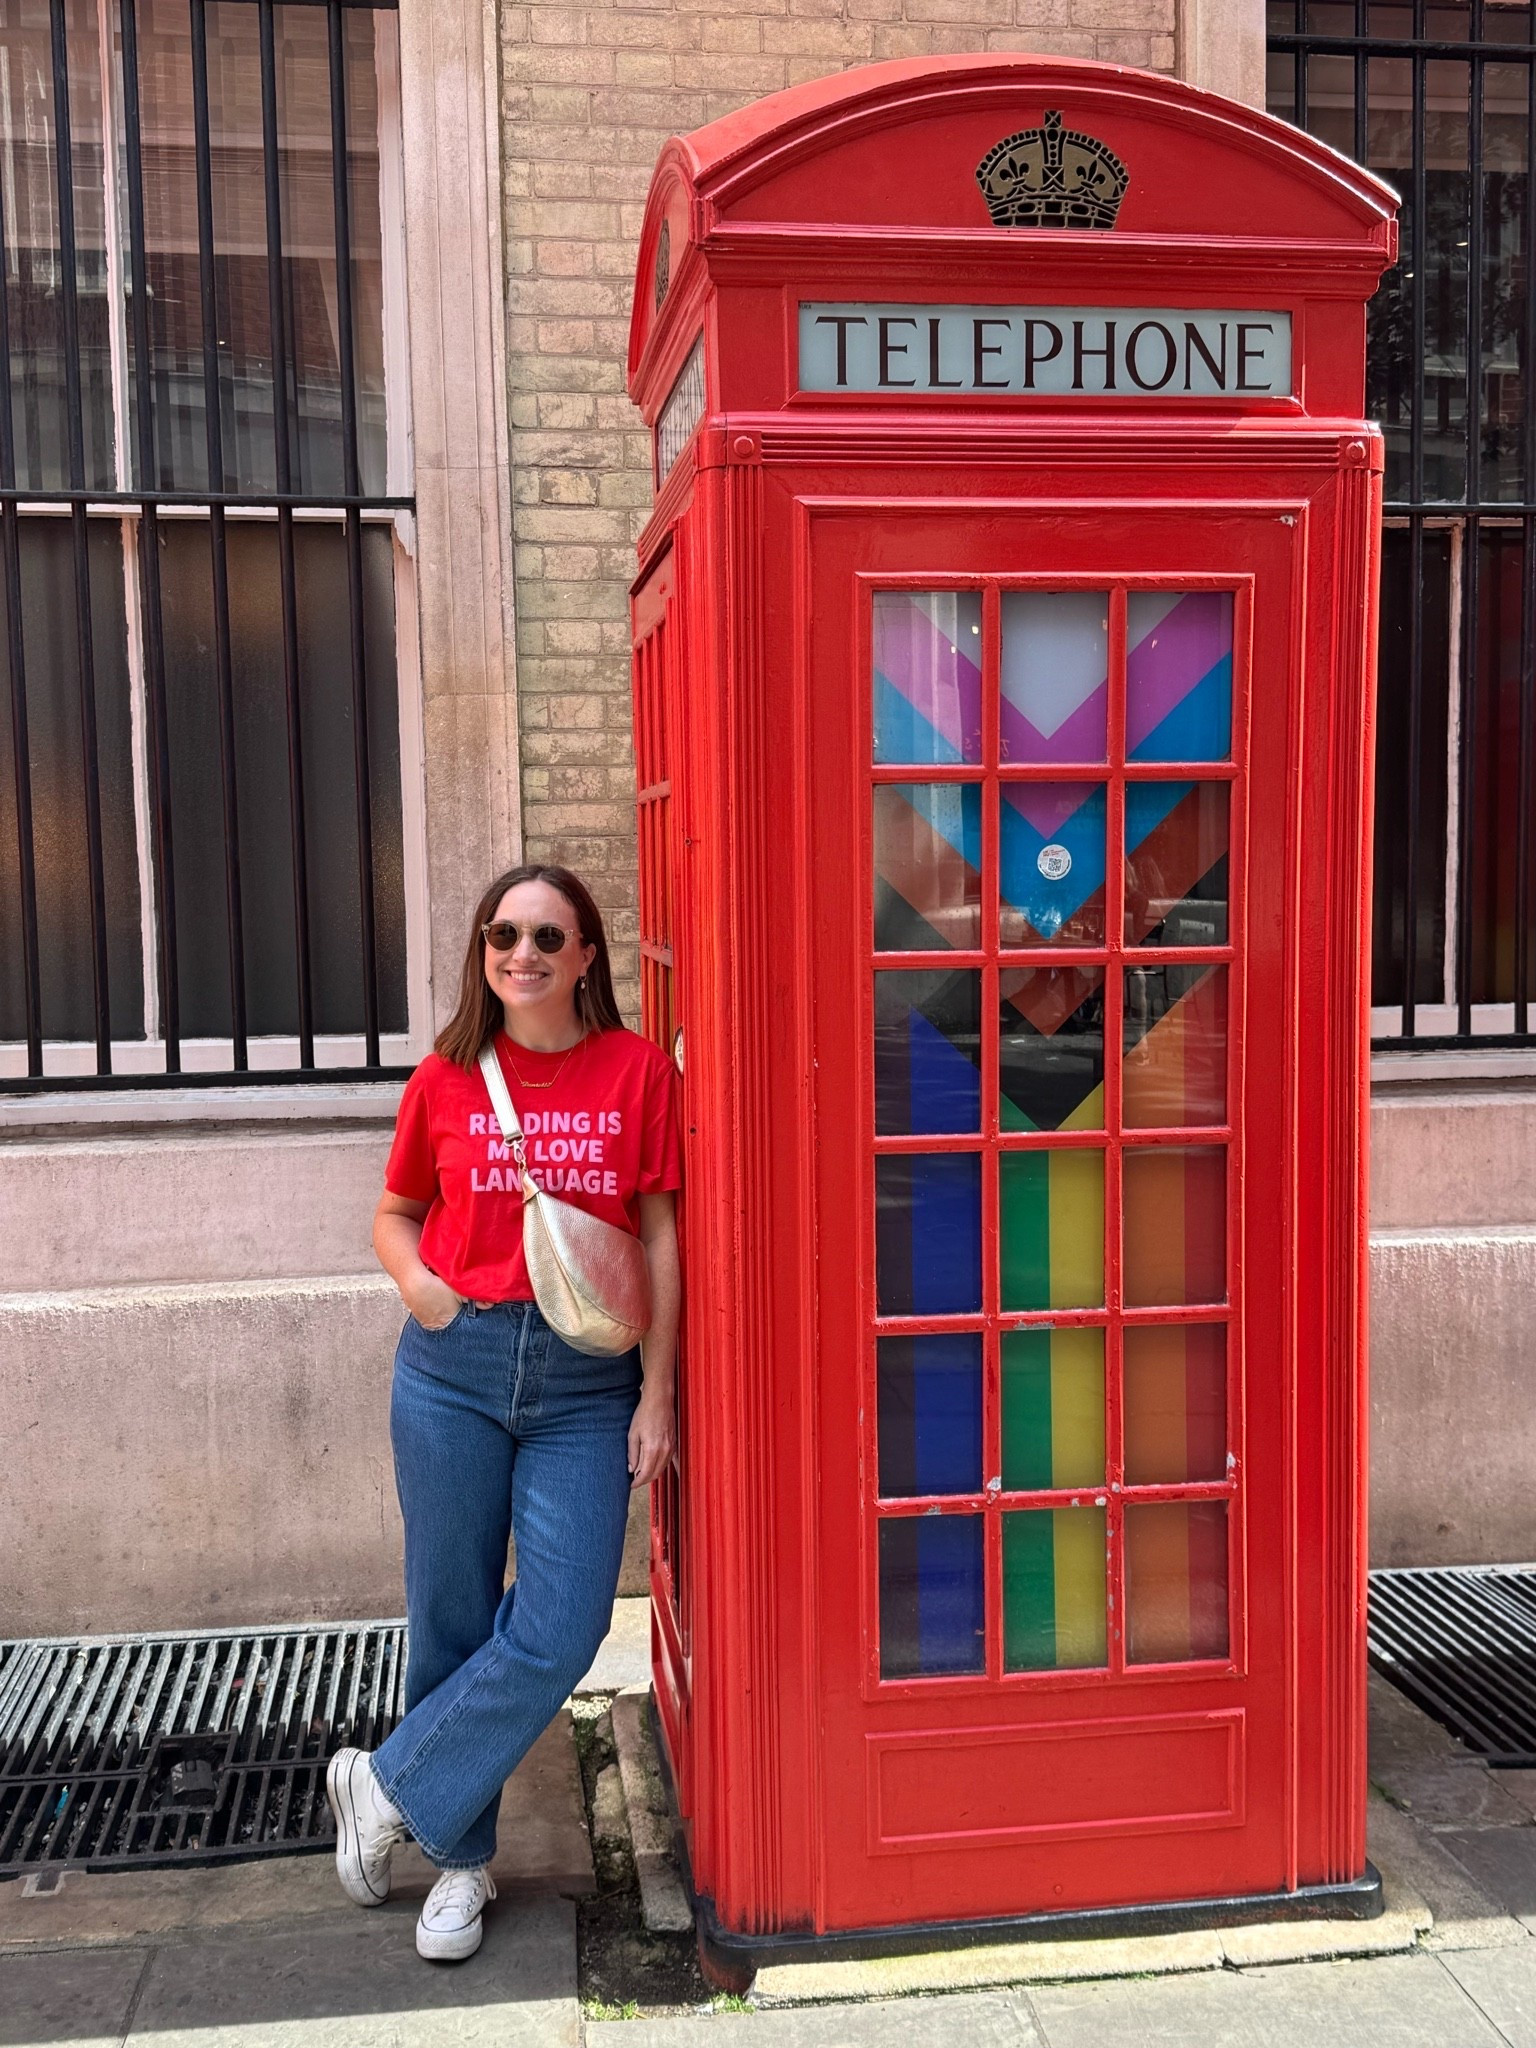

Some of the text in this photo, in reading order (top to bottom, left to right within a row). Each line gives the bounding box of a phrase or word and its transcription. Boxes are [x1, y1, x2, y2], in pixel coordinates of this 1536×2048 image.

[814, 315, 1274, 391] TELEPHONE
[469, 1111, 622, 1136] REDING IS
[534, 1138, 604, 1163] LOVE
[470, 1167, 618, 1196] LANGUAGE
